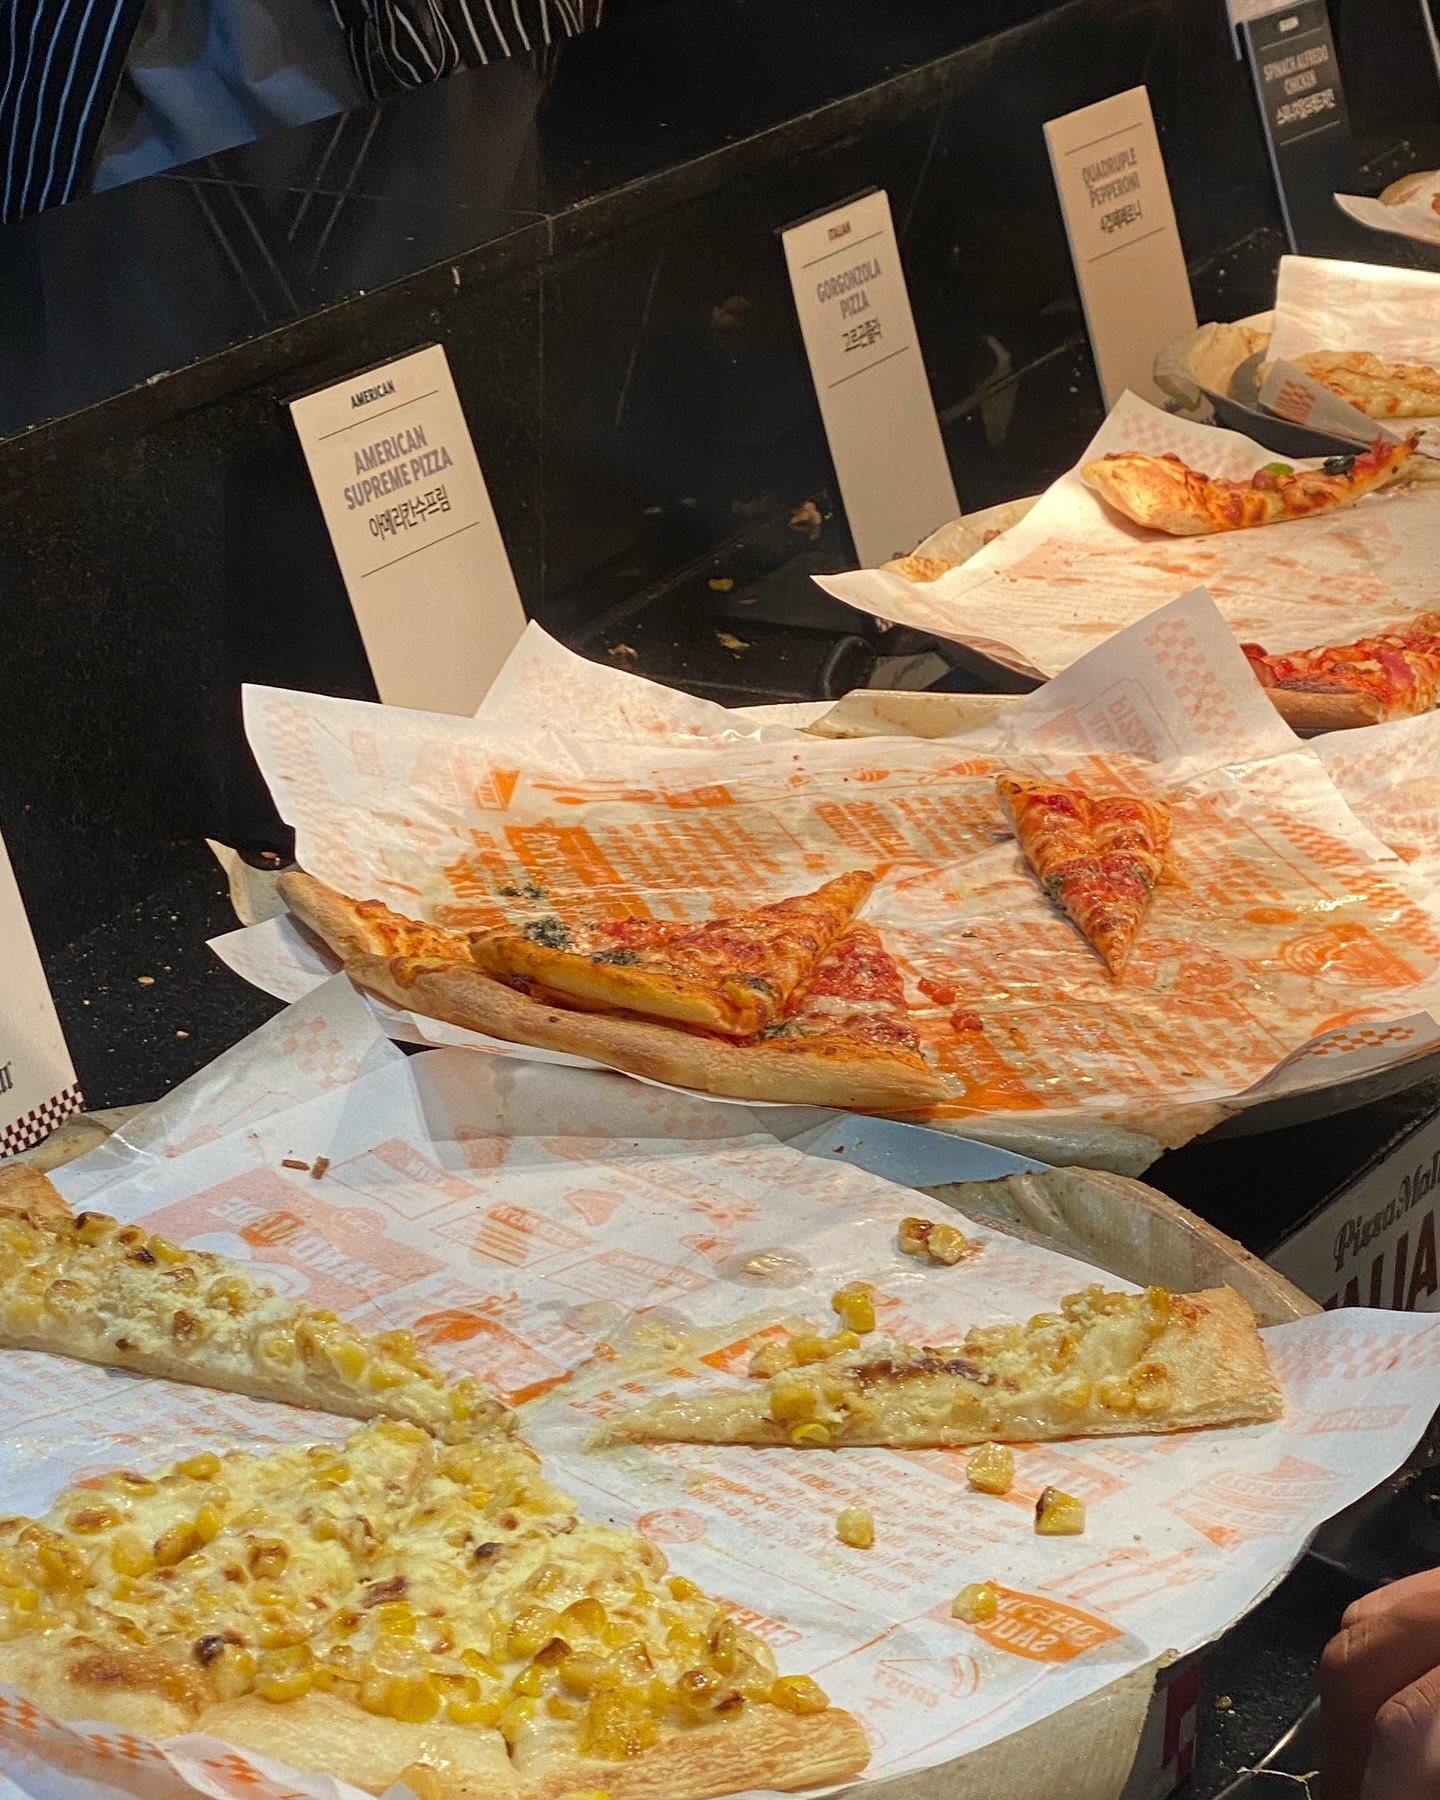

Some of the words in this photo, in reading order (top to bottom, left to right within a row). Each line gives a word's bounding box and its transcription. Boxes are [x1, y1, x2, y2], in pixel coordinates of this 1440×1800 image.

[1082, 148, 1137, 188] QUADRUPLE
[816, 257, 882, 303] GORGONZOLA
[839, 290, 870, 319] PIZZA
[350, 379, 396, 409] AMERICAN
[354, 424, 428, 475] AMERICAN
[343, 463, 413, 511] SUPREME
[409, 446, 454, 482] PIZZA
[368, 484, 451, 541] 아메리칸수프림
[1396, 1149, 1440, 1217] Mal
